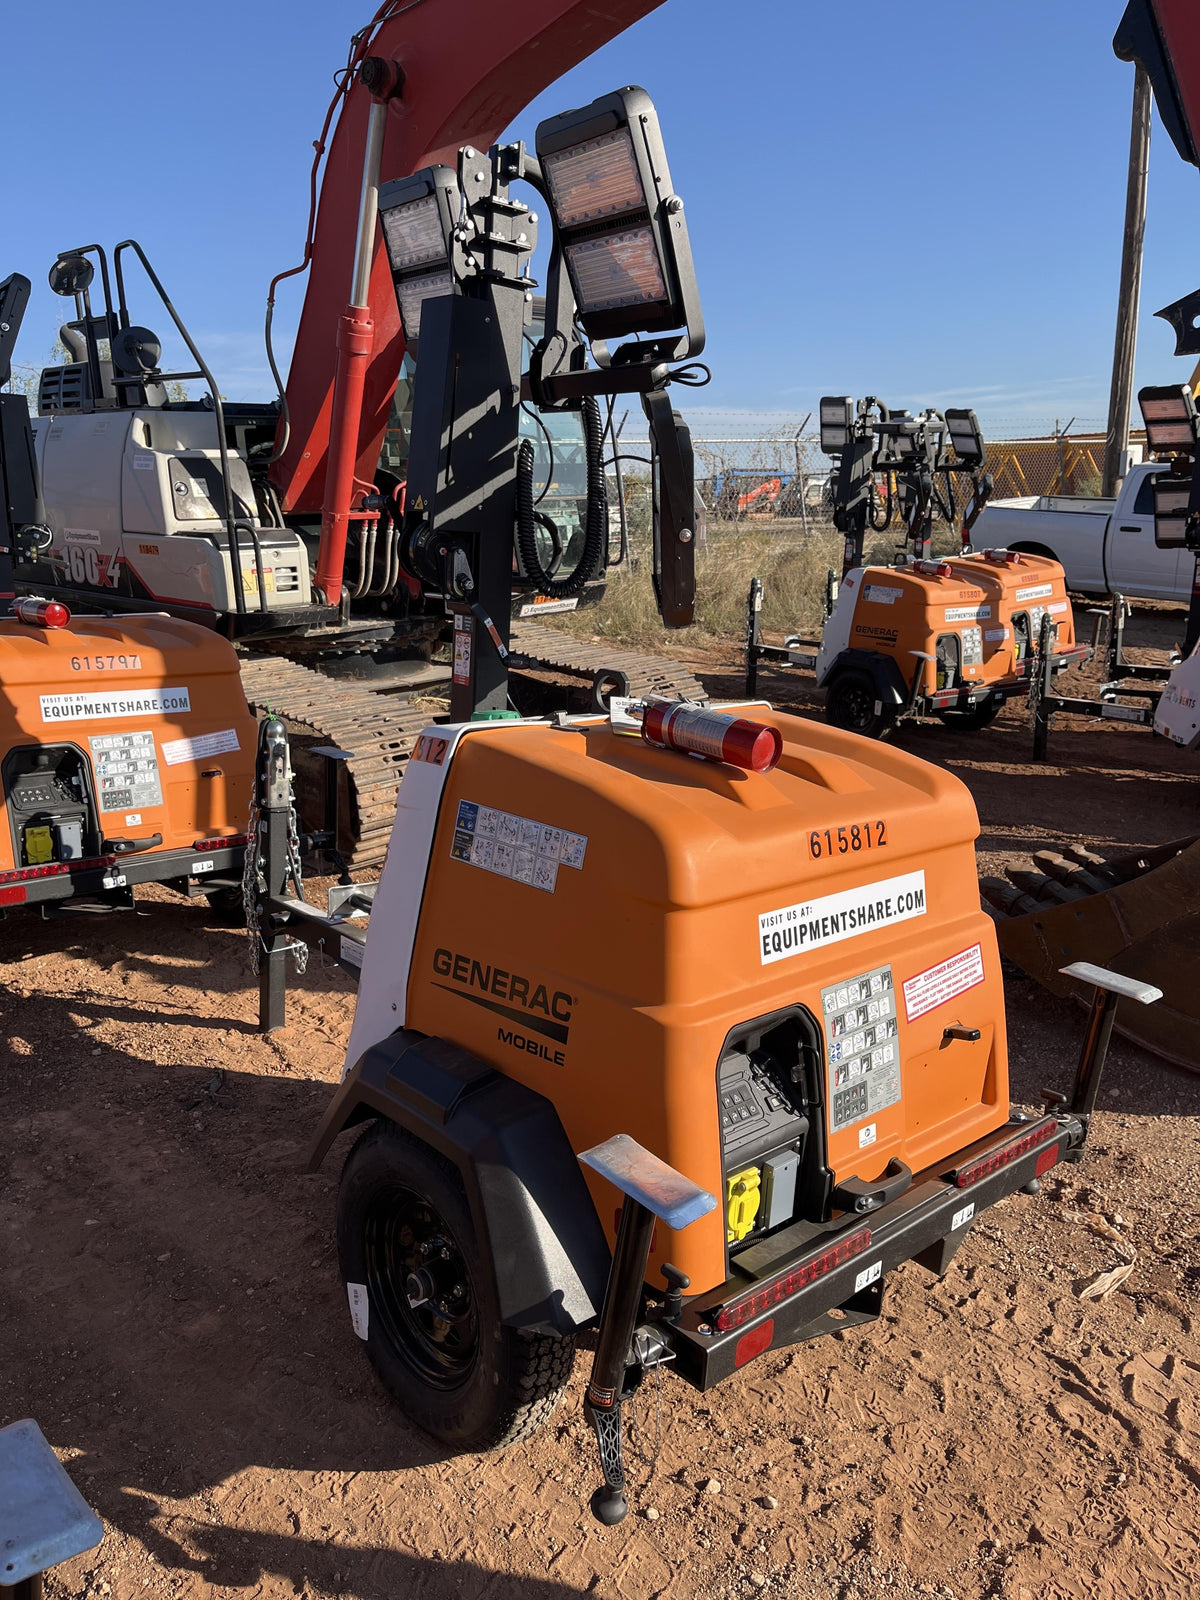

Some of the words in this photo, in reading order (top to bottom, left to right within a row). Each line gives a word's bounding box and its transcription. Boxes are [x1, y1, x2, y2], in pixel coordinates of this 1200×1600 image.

[529, 602, 575, 614] EquipmentShare
[855, 625, 899, 637] GENERAC
[71, 654, 138, 671] 615797
[41, 696, 61, 704] VISIT
[43, 697, 188, 718] EQUIPMENTSHARE.COM
[809, 820, 887, 859] 615812
[761, 914, 783, 928] VISIT
[786, 912, 797, 922] US
[801, 906, 813, 918] AT:
[762, 889, 924, 956] EQUIPMENTSHARE.COM
[923, 965, 947, 982] CUSTOMER
[946, 948, 979, 969] RESPONSIBILITY
[433, 948, 573, 1022] GENERAC
[497, 1028, 566, 1067] MOBILE
